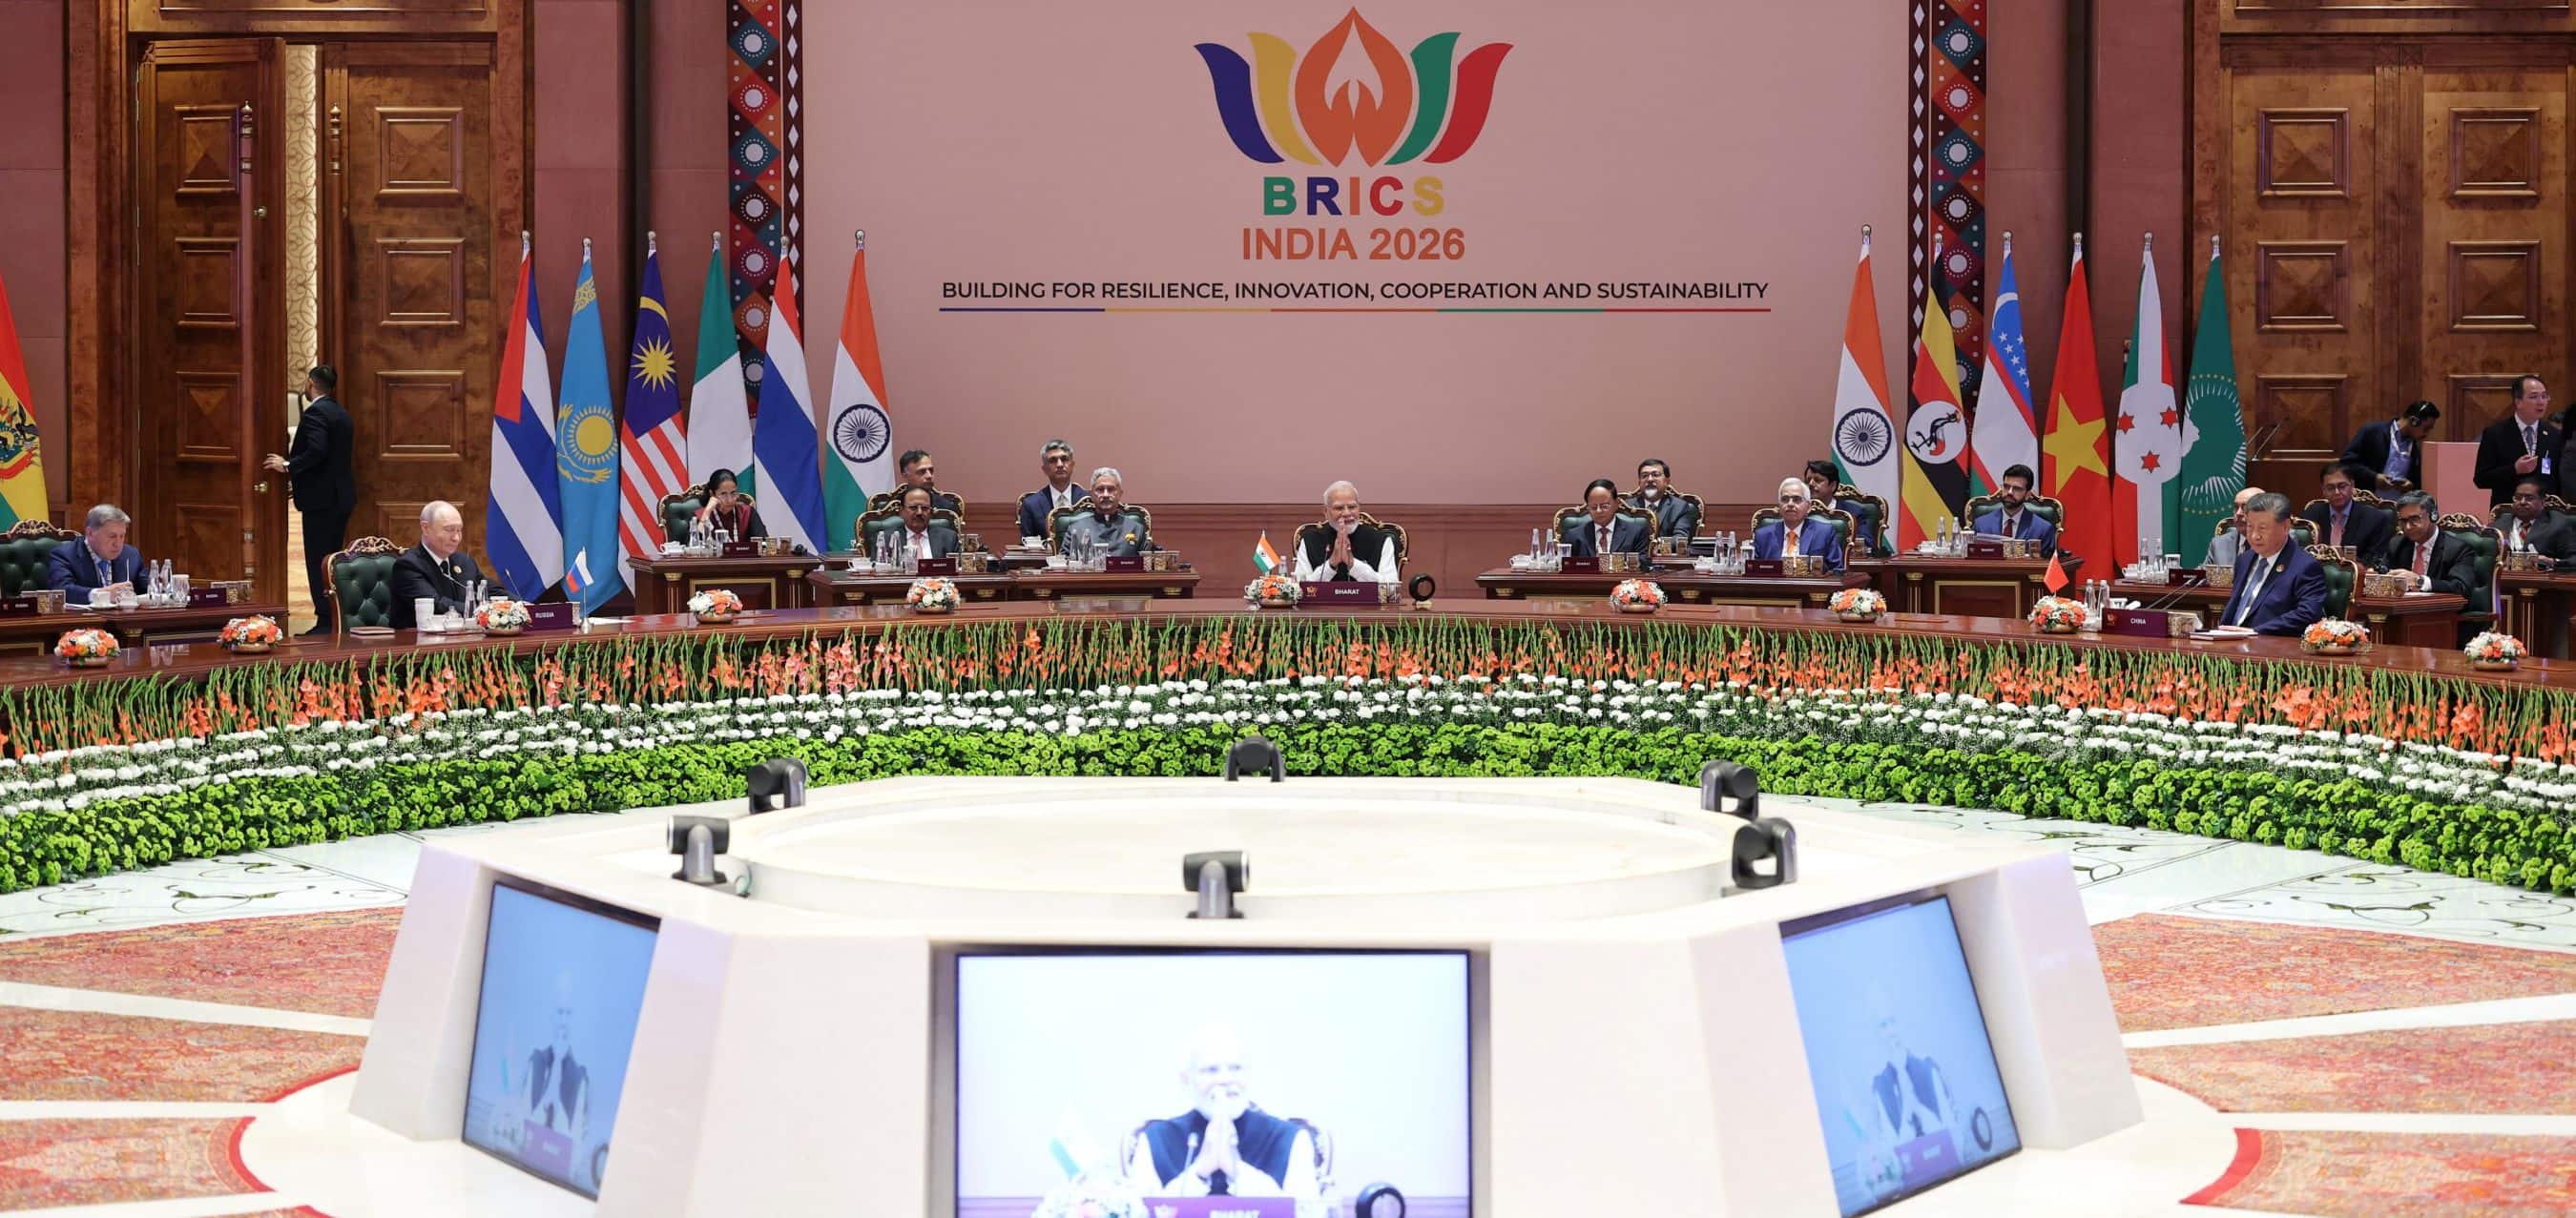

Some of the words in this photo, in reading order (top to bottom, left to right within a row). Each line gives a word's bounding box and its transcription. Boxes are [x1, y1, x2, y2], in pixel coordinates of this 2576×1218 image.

[1263, 175, 1444, 217] BRICS
[1243, 228, 1358, 259] INDIA
[1369, 228, 1465, 260] 2026
[943, 282, 1046, 299] BUILDING
[1052, 282, 1096, 299] FOR
[1102, 282, 1230, 302] RESILIENCE,
[1235, 282, 1375, 302] INNOVATION,
[1381, 282, 1537, 299] COOPERATION
[1542, 282, 1592, 299] AND
[1597, 282, 1769, 299] SUSTAINABILITY
